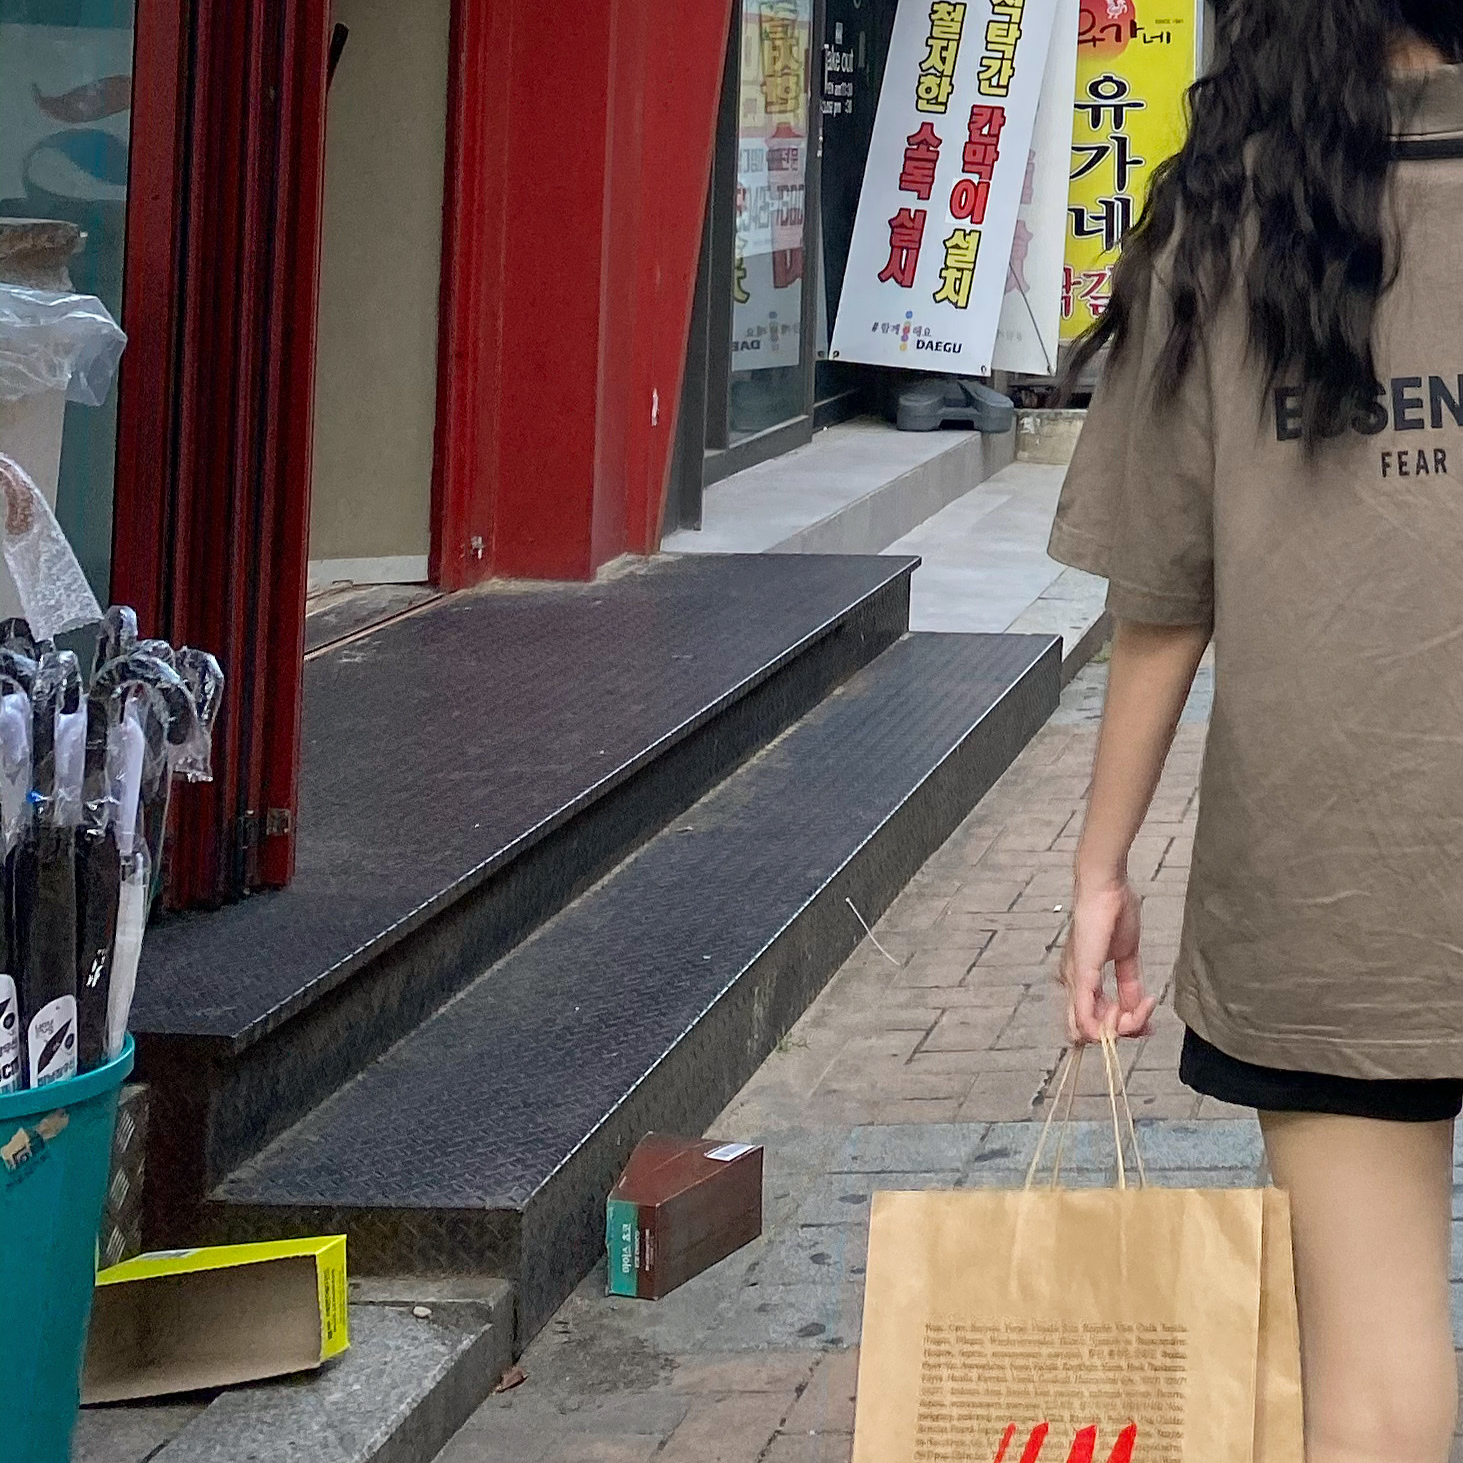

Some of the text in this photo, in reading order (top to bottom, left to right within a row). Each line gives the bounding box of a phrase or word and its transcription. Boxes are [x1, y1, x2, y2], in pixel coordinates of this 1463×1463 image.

[877, 1, 967, 288] 철저한 소독 실시
[949, 104, 1006, 225] 칸막이
[932, 228, 982, 309] 설치
[916, 339, 962, 353] DAEGU
[1381, 448, 1448, 478] FEAR
